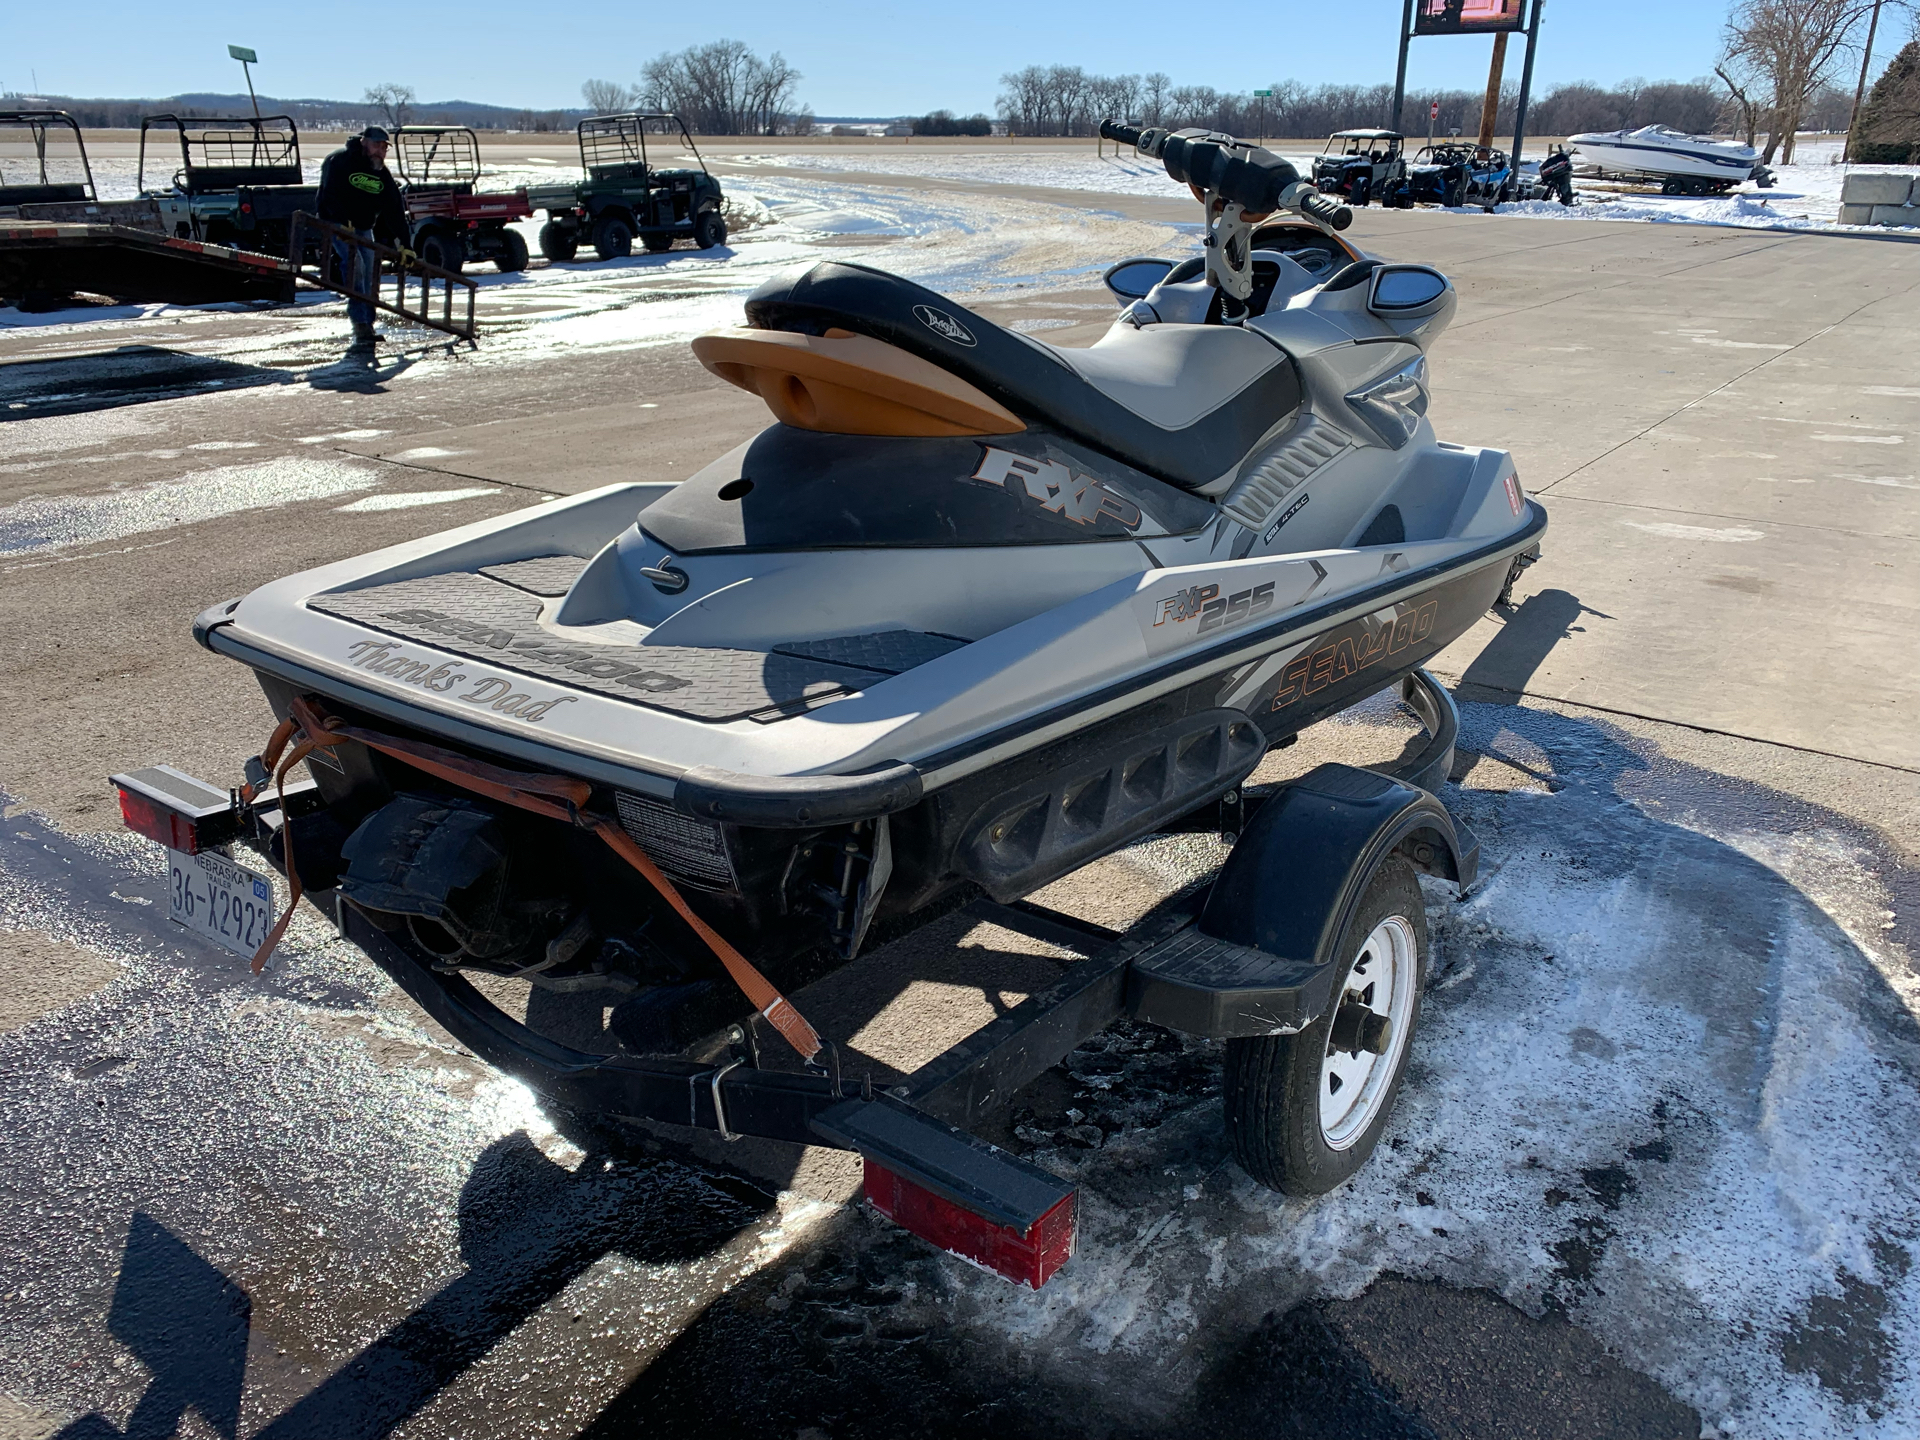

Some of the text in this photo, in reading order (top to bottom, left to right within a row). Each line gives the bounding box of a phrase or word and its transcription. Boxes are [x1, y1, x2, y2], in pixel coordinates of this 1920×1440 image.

[970, 445, 1142, 526] RXP
[1153, 580, 1276, 635] RXP 255
[347, 640, 579, 722] Thanks Dad
[194, 855, 245, 888] NEBRASKA
[205, 871, 232, 891] TRAILER
[255, 884, 265, 897] 05
[173, 867, 268, 949] 36-X2923
